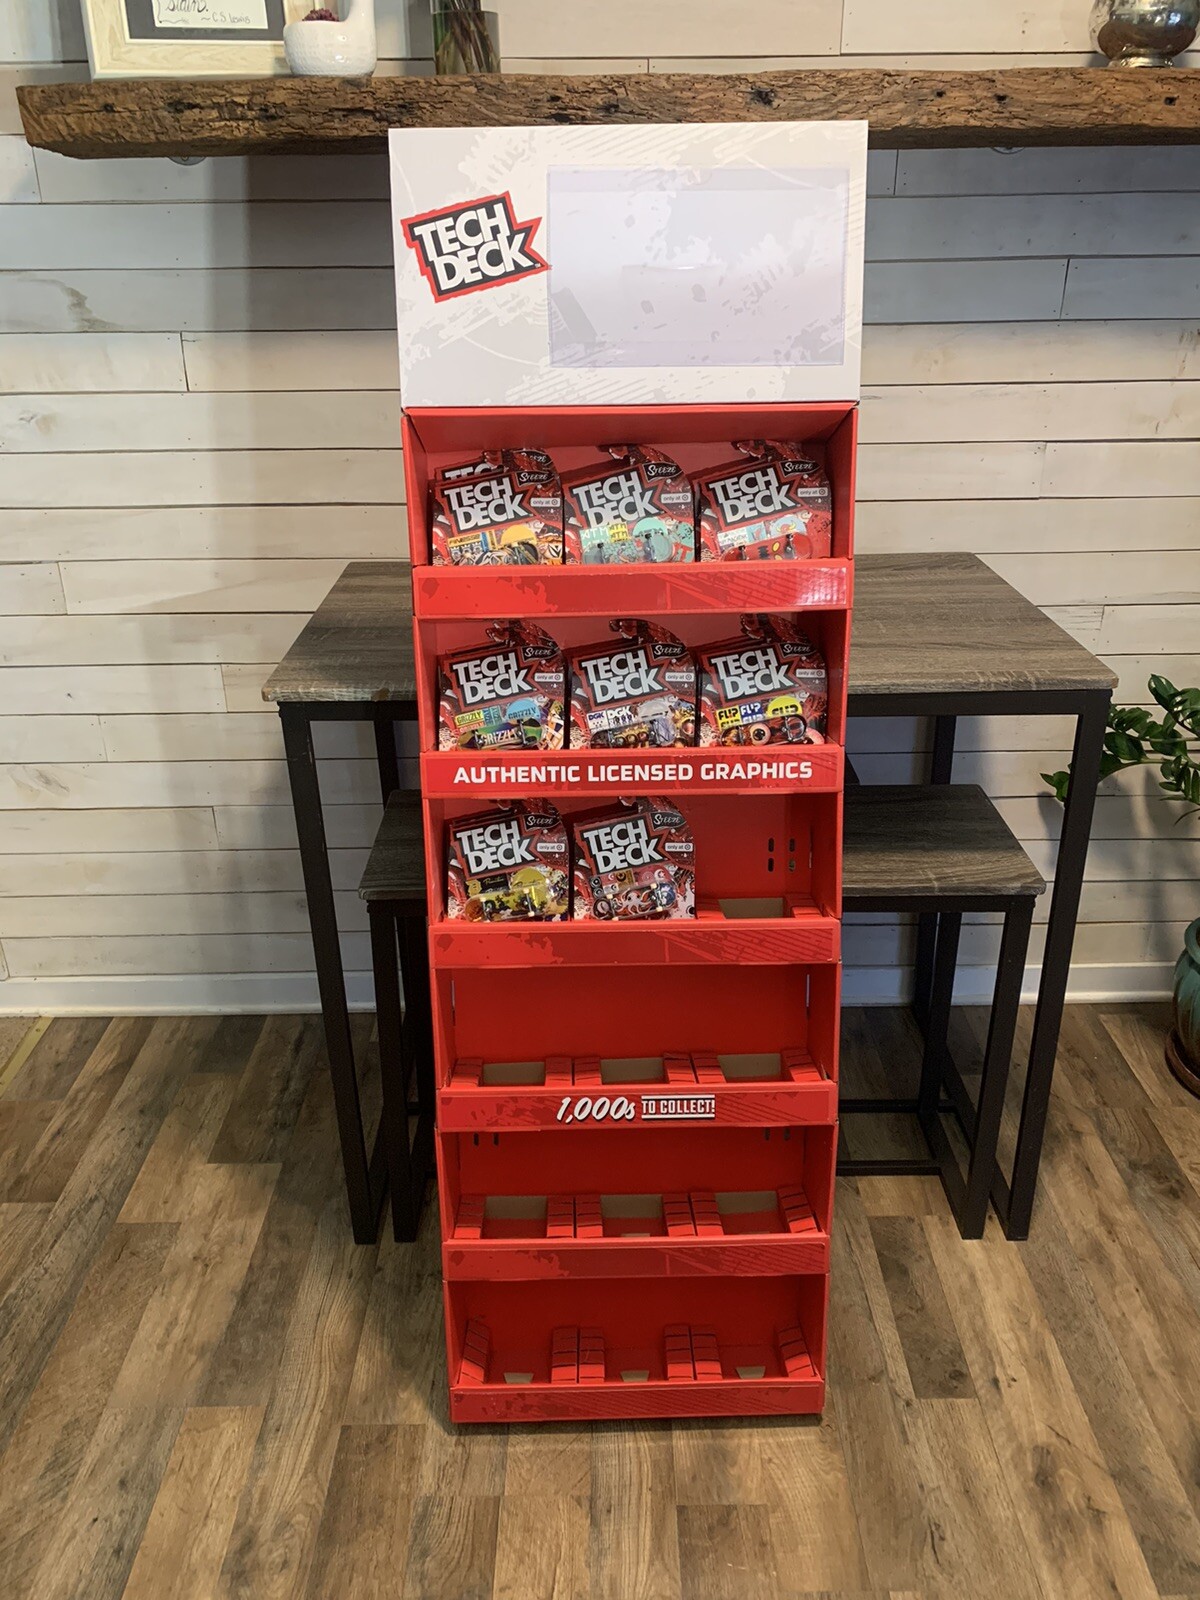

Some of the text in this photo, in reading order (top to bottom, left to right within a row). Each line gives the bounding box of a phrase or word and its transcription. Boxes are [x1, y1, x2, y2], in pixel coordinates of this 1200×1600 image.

[413, 203, 510, 262] TECH
[433, 232, 534, 291] DECK
[444, 477, 513, 510] TECH
[572, 471, 642, 511] TECH
[708, 467, 779, 503] TECH
[455, 494, 529, 531] DECK
[586, 490, 660, 529] DECK
[721, 484, 796, 523] DECK
[453, 652, 518, 685] TECH
[581, 650, 648, 683] TECH
[711, 648, 778, 680] TECH
[463, 669, 533, 704] DECK
[593, 668, 663, 704] DECK
[722, 664, 794, 700] DECK
[456, 711, 482, 725] GRIZZLY
[588, 711, 605, 720] DGK
[608, 705, 632, 718] DGK
[453, 761, 813, 784] AUTHENTIC LICENSED GRAPHICS
[456, 820, 521, 855] TECH
[583, 819, 648, 854] TECH
[467, 838, 535, 874] DECK
[595, 838, 663, 873] DECK
[556, 1096, 715, 1123] 1,000s TO COLLECT!
